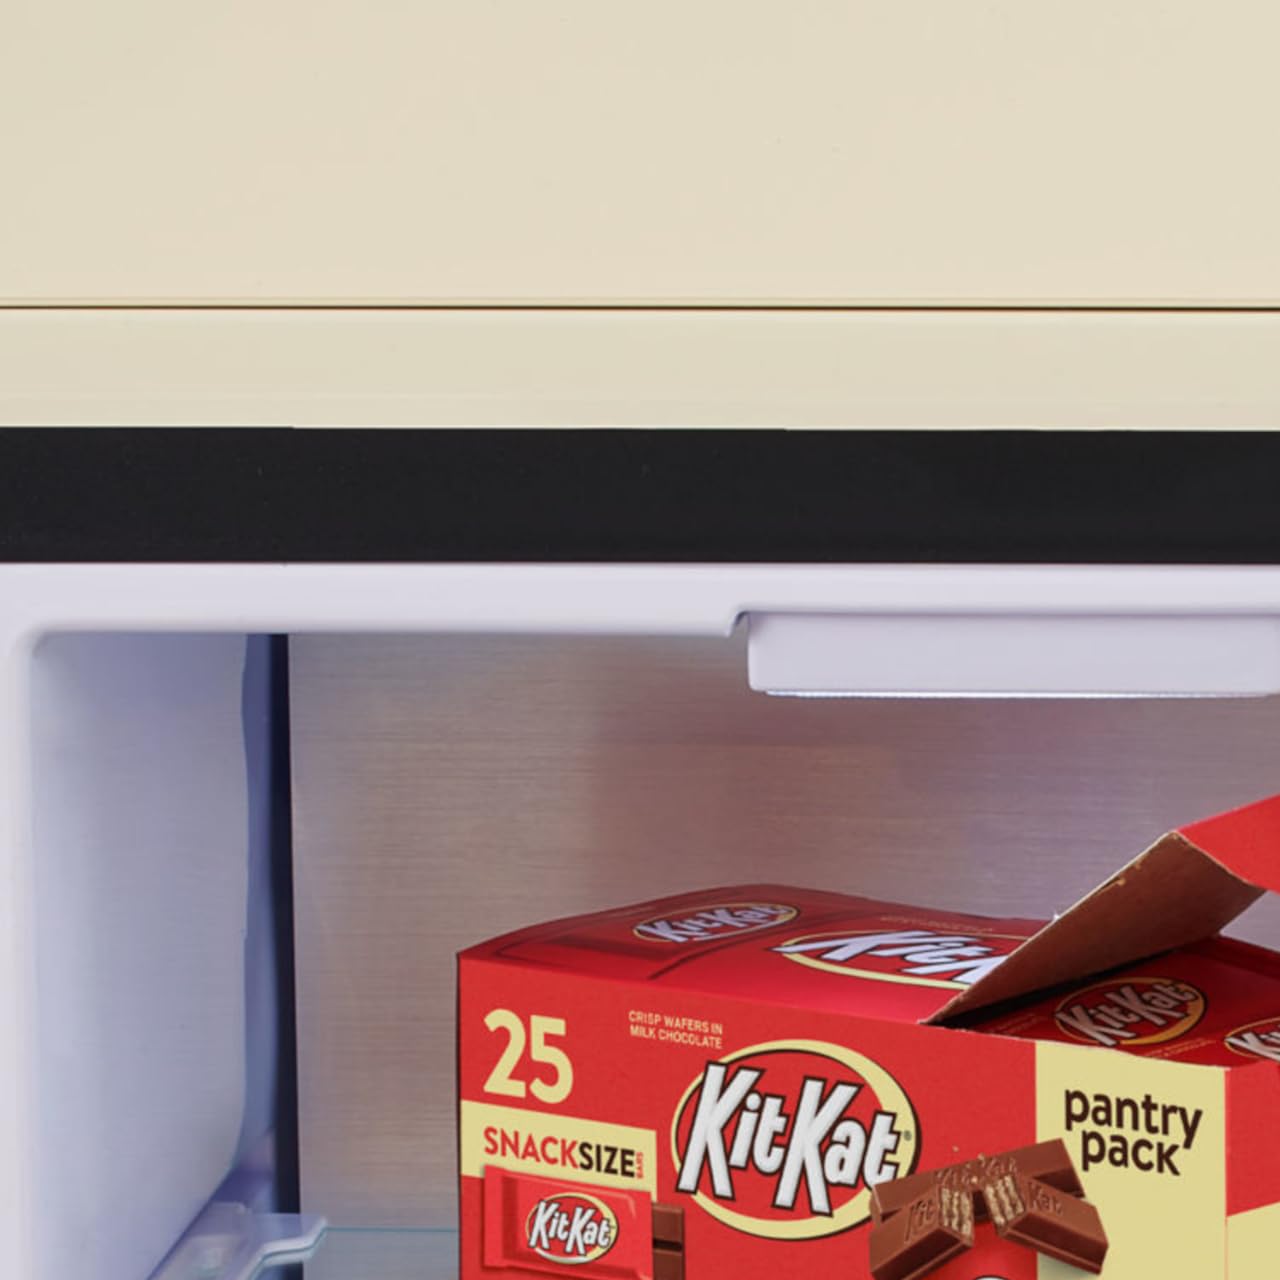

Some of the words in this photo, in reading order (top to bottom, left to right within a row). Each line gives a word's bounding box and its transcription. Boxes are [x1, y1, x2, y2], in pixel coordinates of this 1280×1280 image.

[628, 1010, 661, 1025] CRISP
[664, 1015, 709, 1033] WAFERS
[711, 1023, 723, 1034] IN
[630, 1024, 656, 1039] MILK
[658, 1028, 723, 1049] CHOCOLATE
[1055, 983, 1198, 1047] KitKat
[482, 1008, 575, 1104] 25
[675, 1060, 904, 1217] KitKat
[1064, 1087, 1204, 1150] pantry
[1080, 1129, 1182, 1176] pack
[528, 1199, 613, 1256] KitKat
